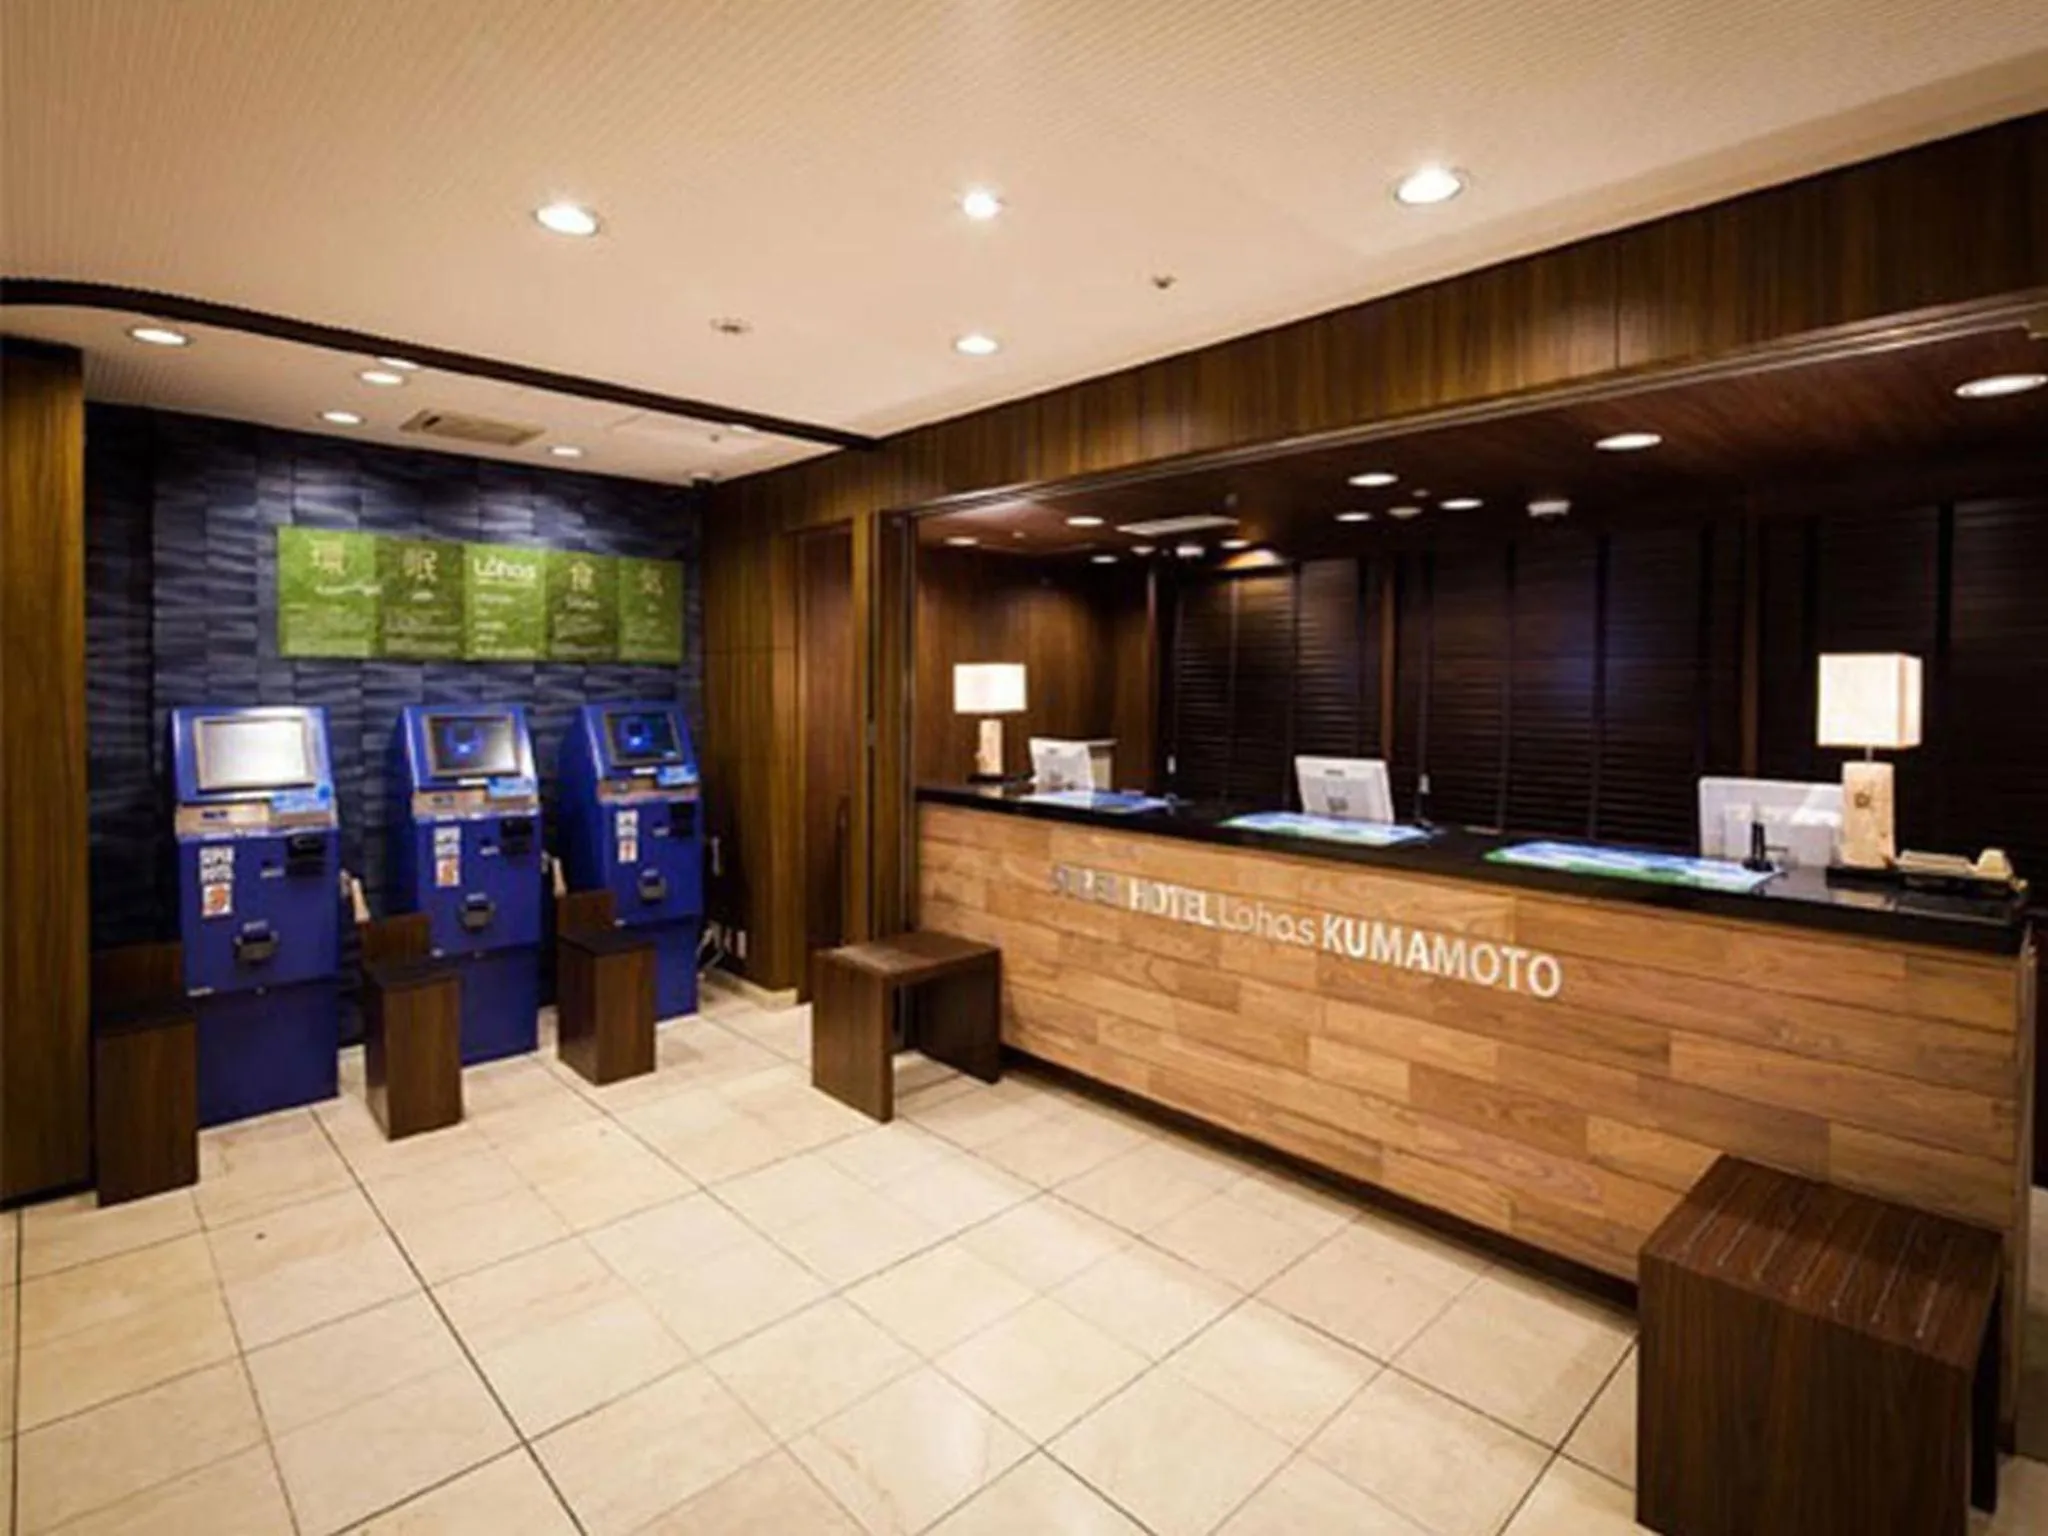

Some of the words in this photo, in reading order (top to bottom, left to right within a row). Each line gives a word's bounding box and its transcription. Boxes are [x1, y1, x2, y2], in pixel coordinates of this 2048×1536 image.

[1129, 877, 1215, 927] HOTEL
[1219, 892, 1316, 947] Lohas
[1321, 913, 1563, 999] KUMAMOTO
